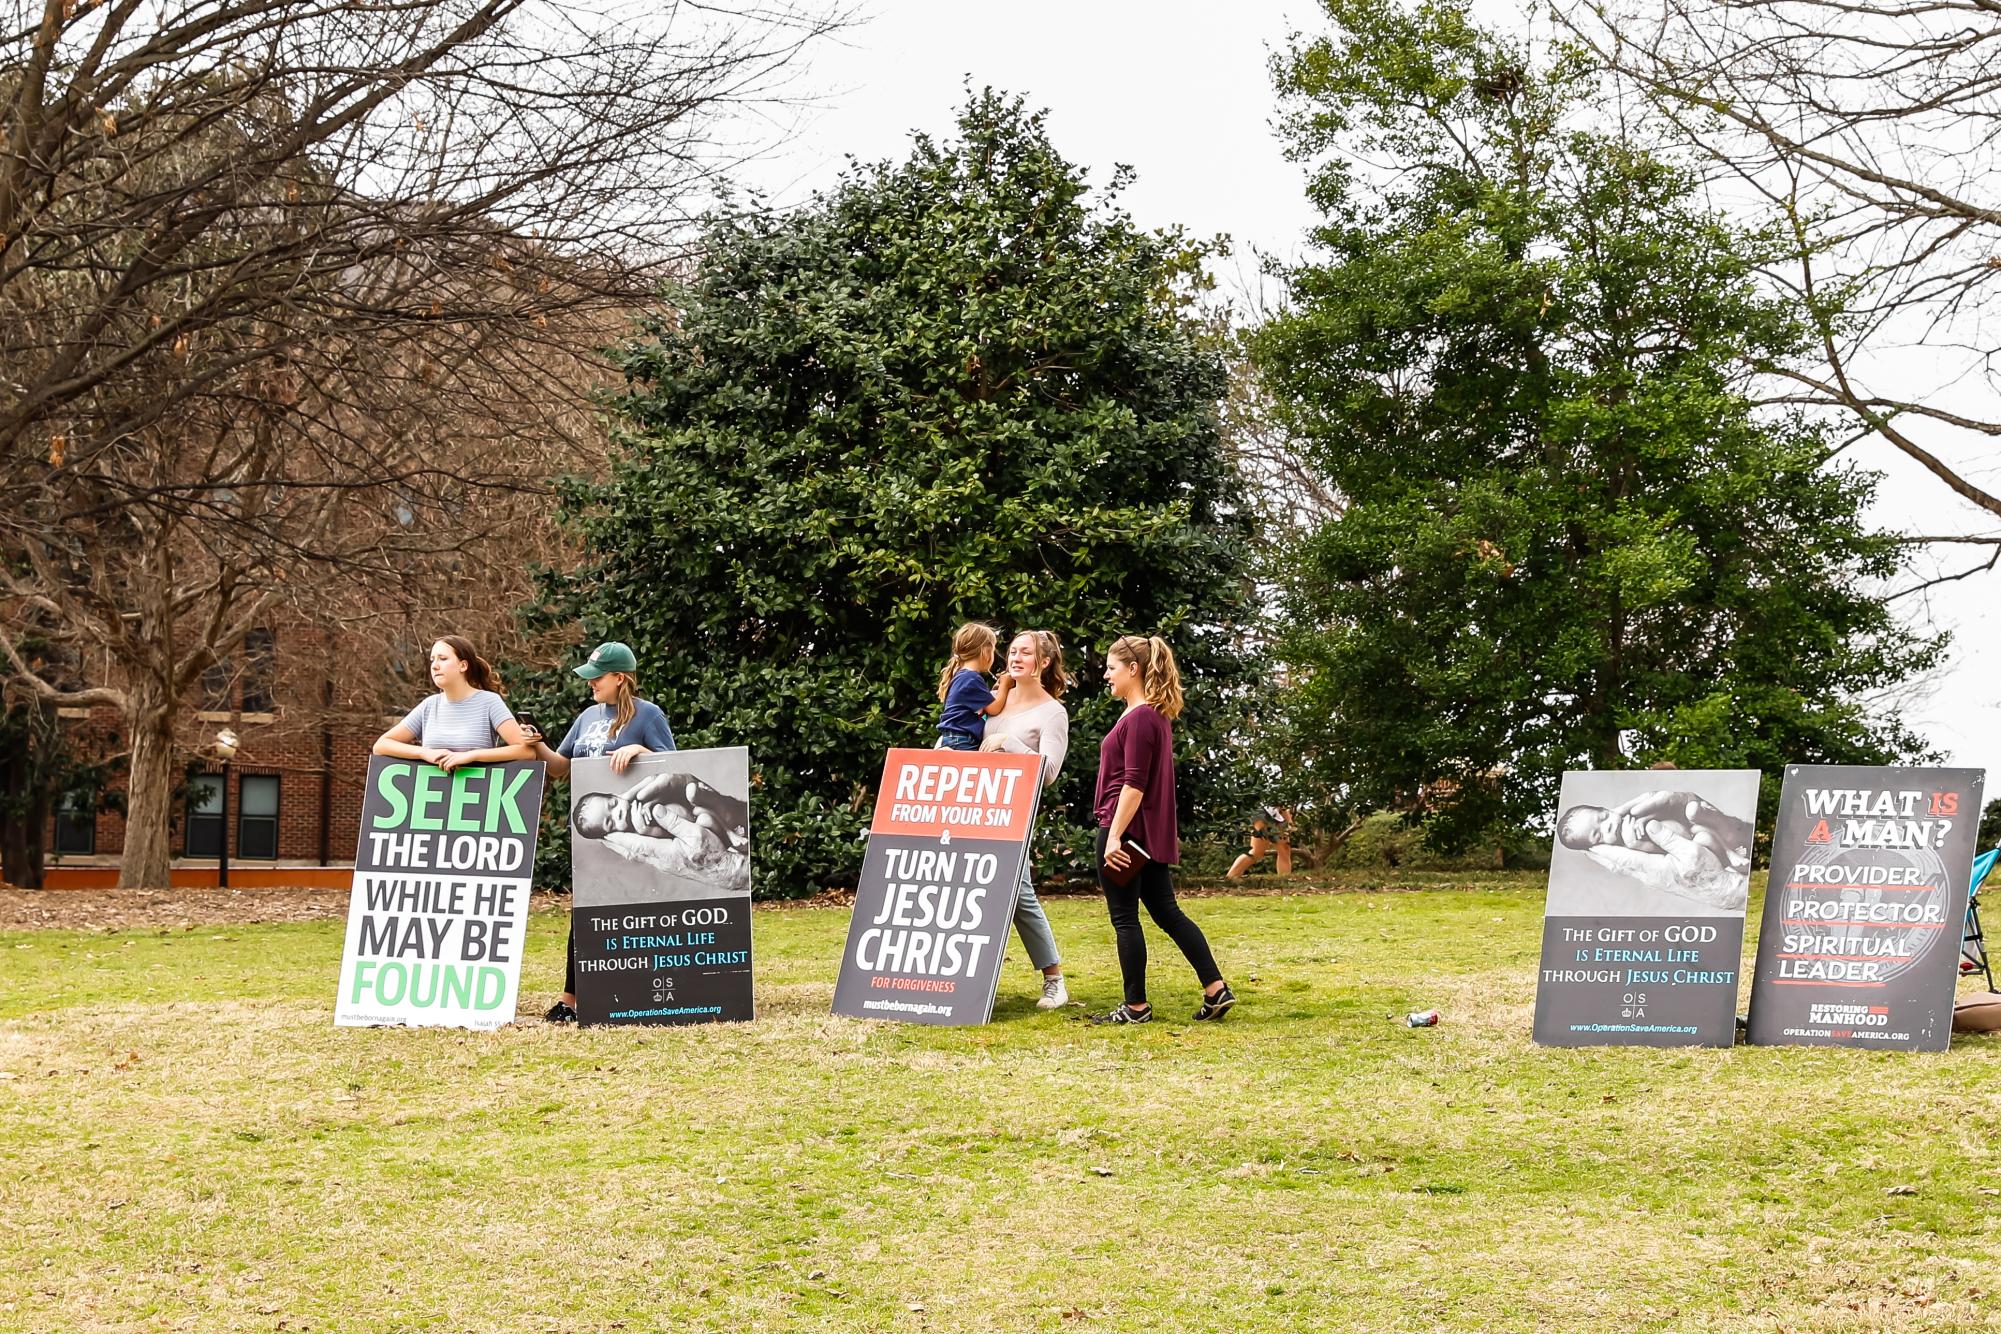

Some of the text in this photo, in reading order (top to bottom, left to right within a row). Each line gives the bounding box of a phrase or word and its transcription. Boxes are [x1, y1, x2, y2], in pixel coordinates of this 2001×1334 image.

[895, 764, 1023, 805] REPENT
[373, 763, 535, 835] SEEK
[1804, 789, 1960, 817] WHAT IS
[890, 804, 1012, 827] FROM YOUR SIN
[939, 829, 951, 845] &
[1806, 819, 1952, 848] A MAN?
[369, 832, 524, 871] THE LORD
[884, 848, 998, 885] TURN TO
[1793, 864, 1925, 886] PROVIDER.
[366, 879, 517, 917] WHILE HE
[873, 883, 987, 931] JESUS
[591, 907, 728, 931] THE GIFT OF GOD
[1787, 900, 1945, 923] PROTECTOR.
[357, 915, 513, 963] MAY BE
[606, 932, 715, 950] IS ETERNAL LIFE
[1562, 925, 1717, 943] THE GIFT OF GOD
[855, 928, 990, 978] CHRIST
[1575, 948, 1699, 962] IS ETERNAL LIFE
[1783, 934, 1912, 957] SPIRITUAL
[578, 951, 748, 972] THROUGH JESUS CHRIST
[1779, 960, 1883, 982] LEADER.
[351, 961, 506, 1010] FOUND
[653, 977, 673, 988] O S
[870, 976, 956, 993] FOR FORGIVENESS
[1543, 969, 1734, 986] THROUGH JESUS CHRIST
[666, 991, 674, 1001] A
[1623, 993, 1646, 1004] O S
[341, 1013, 407, 1023] mustbebornagain.org
[609, 1005, 722, 1019] www.OperationSaveAmerica.org
[863, 999, 953, 1017] mustbebornagain.org
[1635, 1007, 1645, 1018] A
[1811, 1004, 1868, 1014] RESTORING
[1570, 1023, 1697, 1035] www.OperationSaveAmerica.org
[1809, 1013, 1888, 1026] MANHOOD
